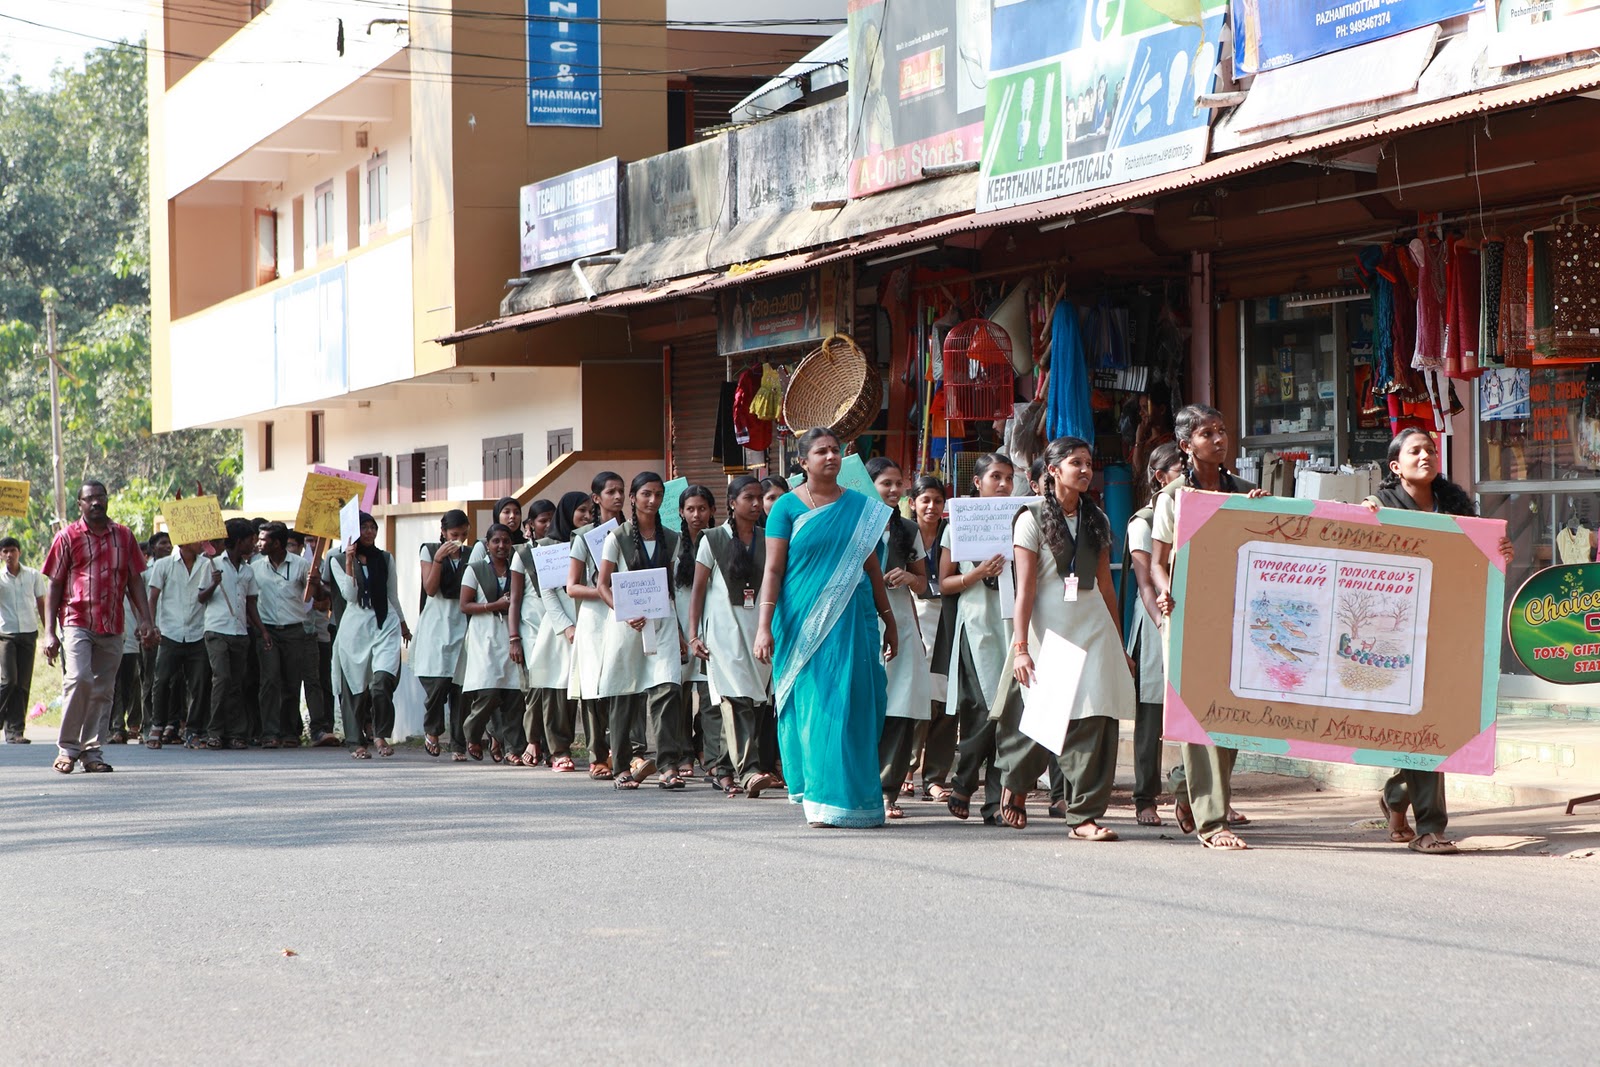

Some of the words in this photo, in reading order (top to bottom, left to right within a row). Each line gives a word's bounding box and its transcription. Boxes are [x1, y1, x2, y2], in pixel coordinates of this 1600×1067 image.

[1315, 0, 1379, 26] PAZHAMTHOTTAM
[1335, 25, 1348, 38] PH:
[1349, 11, 1391, 35] 9495467374
[557, 64, 575, 82] &
[532, 89, 597, 100] PHARMACY
[533, 106, 597, 115] PAZHAMTHOTTAM
[859, 154, 906, 192] A-One
[911, 139, 964, 176] Stores
[986, 169, 1043, 204] KEERTHANA
[1045, 153, 1114, 192] ELECTRICALS
[1555, 380, 1587, 400] DYEING
[1252, 559, 1327, 574] TOMORROW'S
[1339, 566, 1415, 582] TOMORROW'S
[1260, 572, 1327, 587] KERALAM
[1338, 578, 1413, 595] TAMILNADU
[1533, 647, 1569, 660] TOYS,
